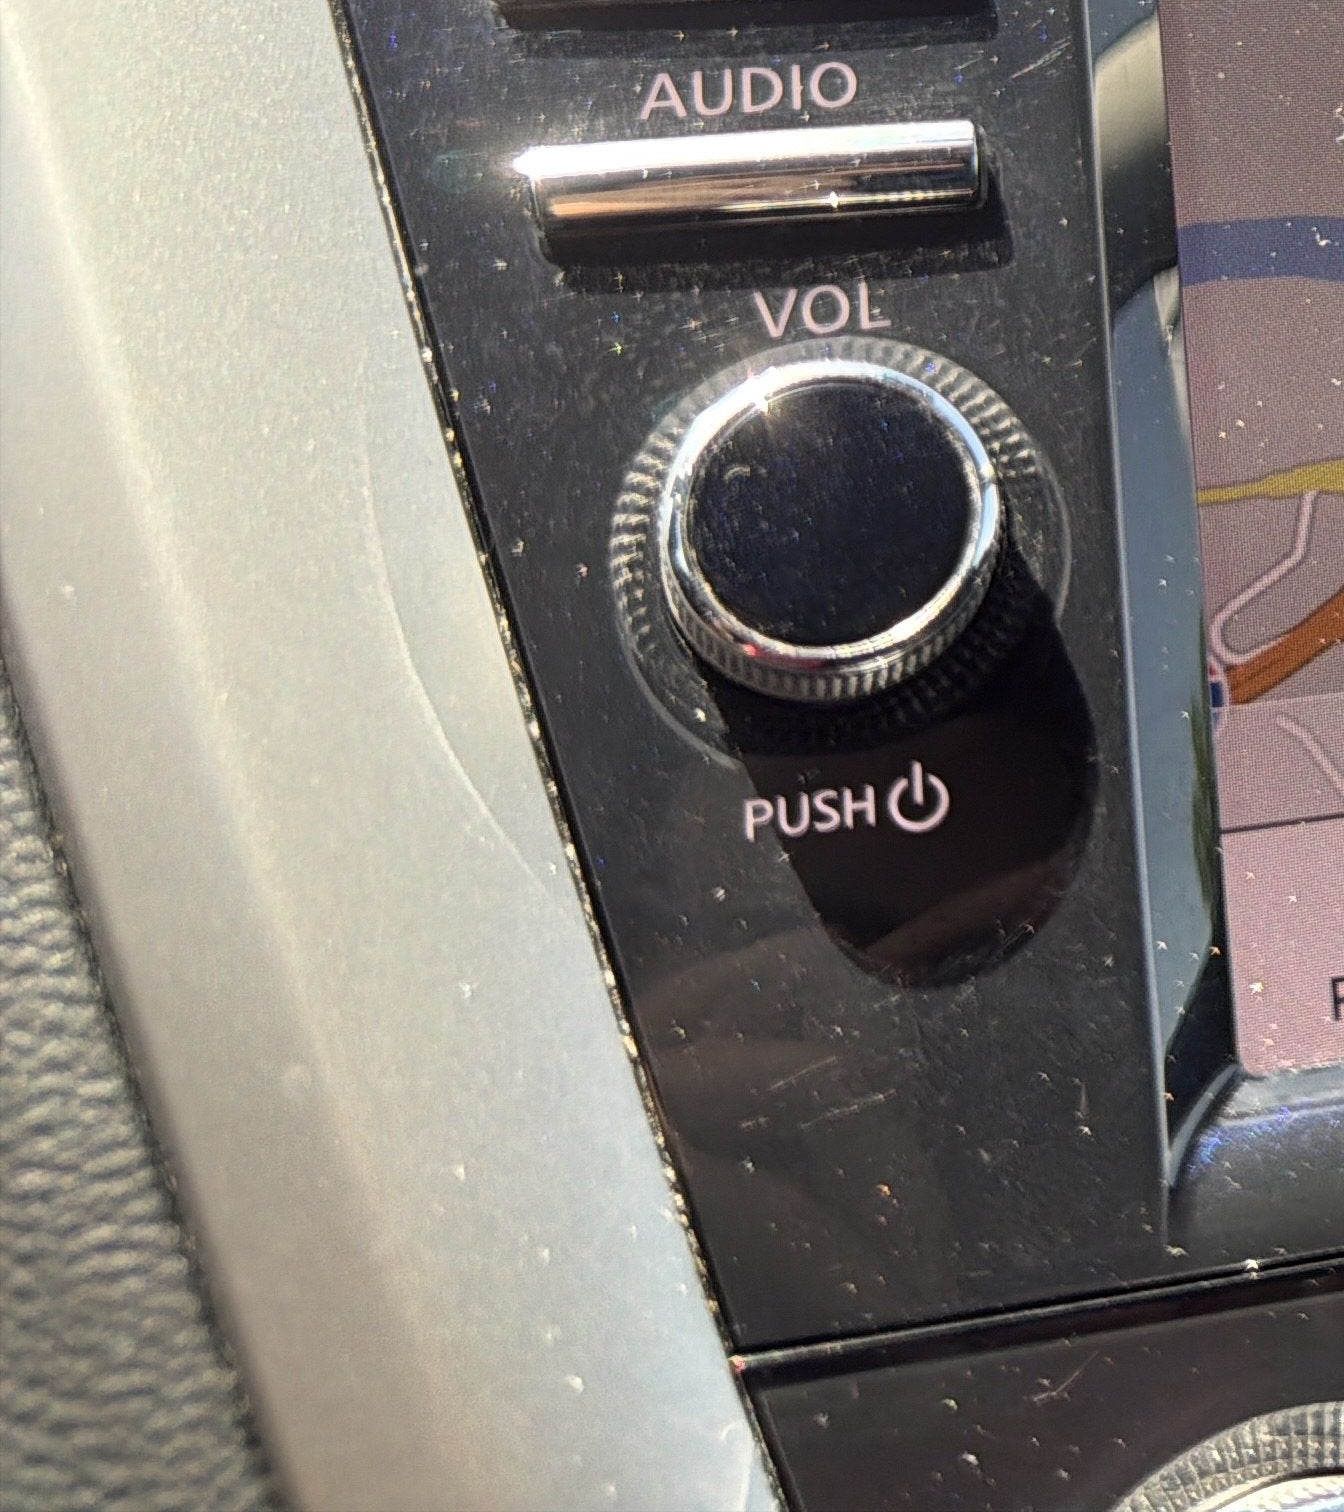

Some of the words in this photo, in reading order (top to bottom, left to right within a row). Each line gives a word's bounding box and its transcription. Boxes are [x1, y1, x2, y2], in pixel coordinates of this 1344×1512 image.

[640, 62, 858, 120] AUDIO
[753, 282, 892, 338] VOL
[744, 786, 876, 842] PUSH
